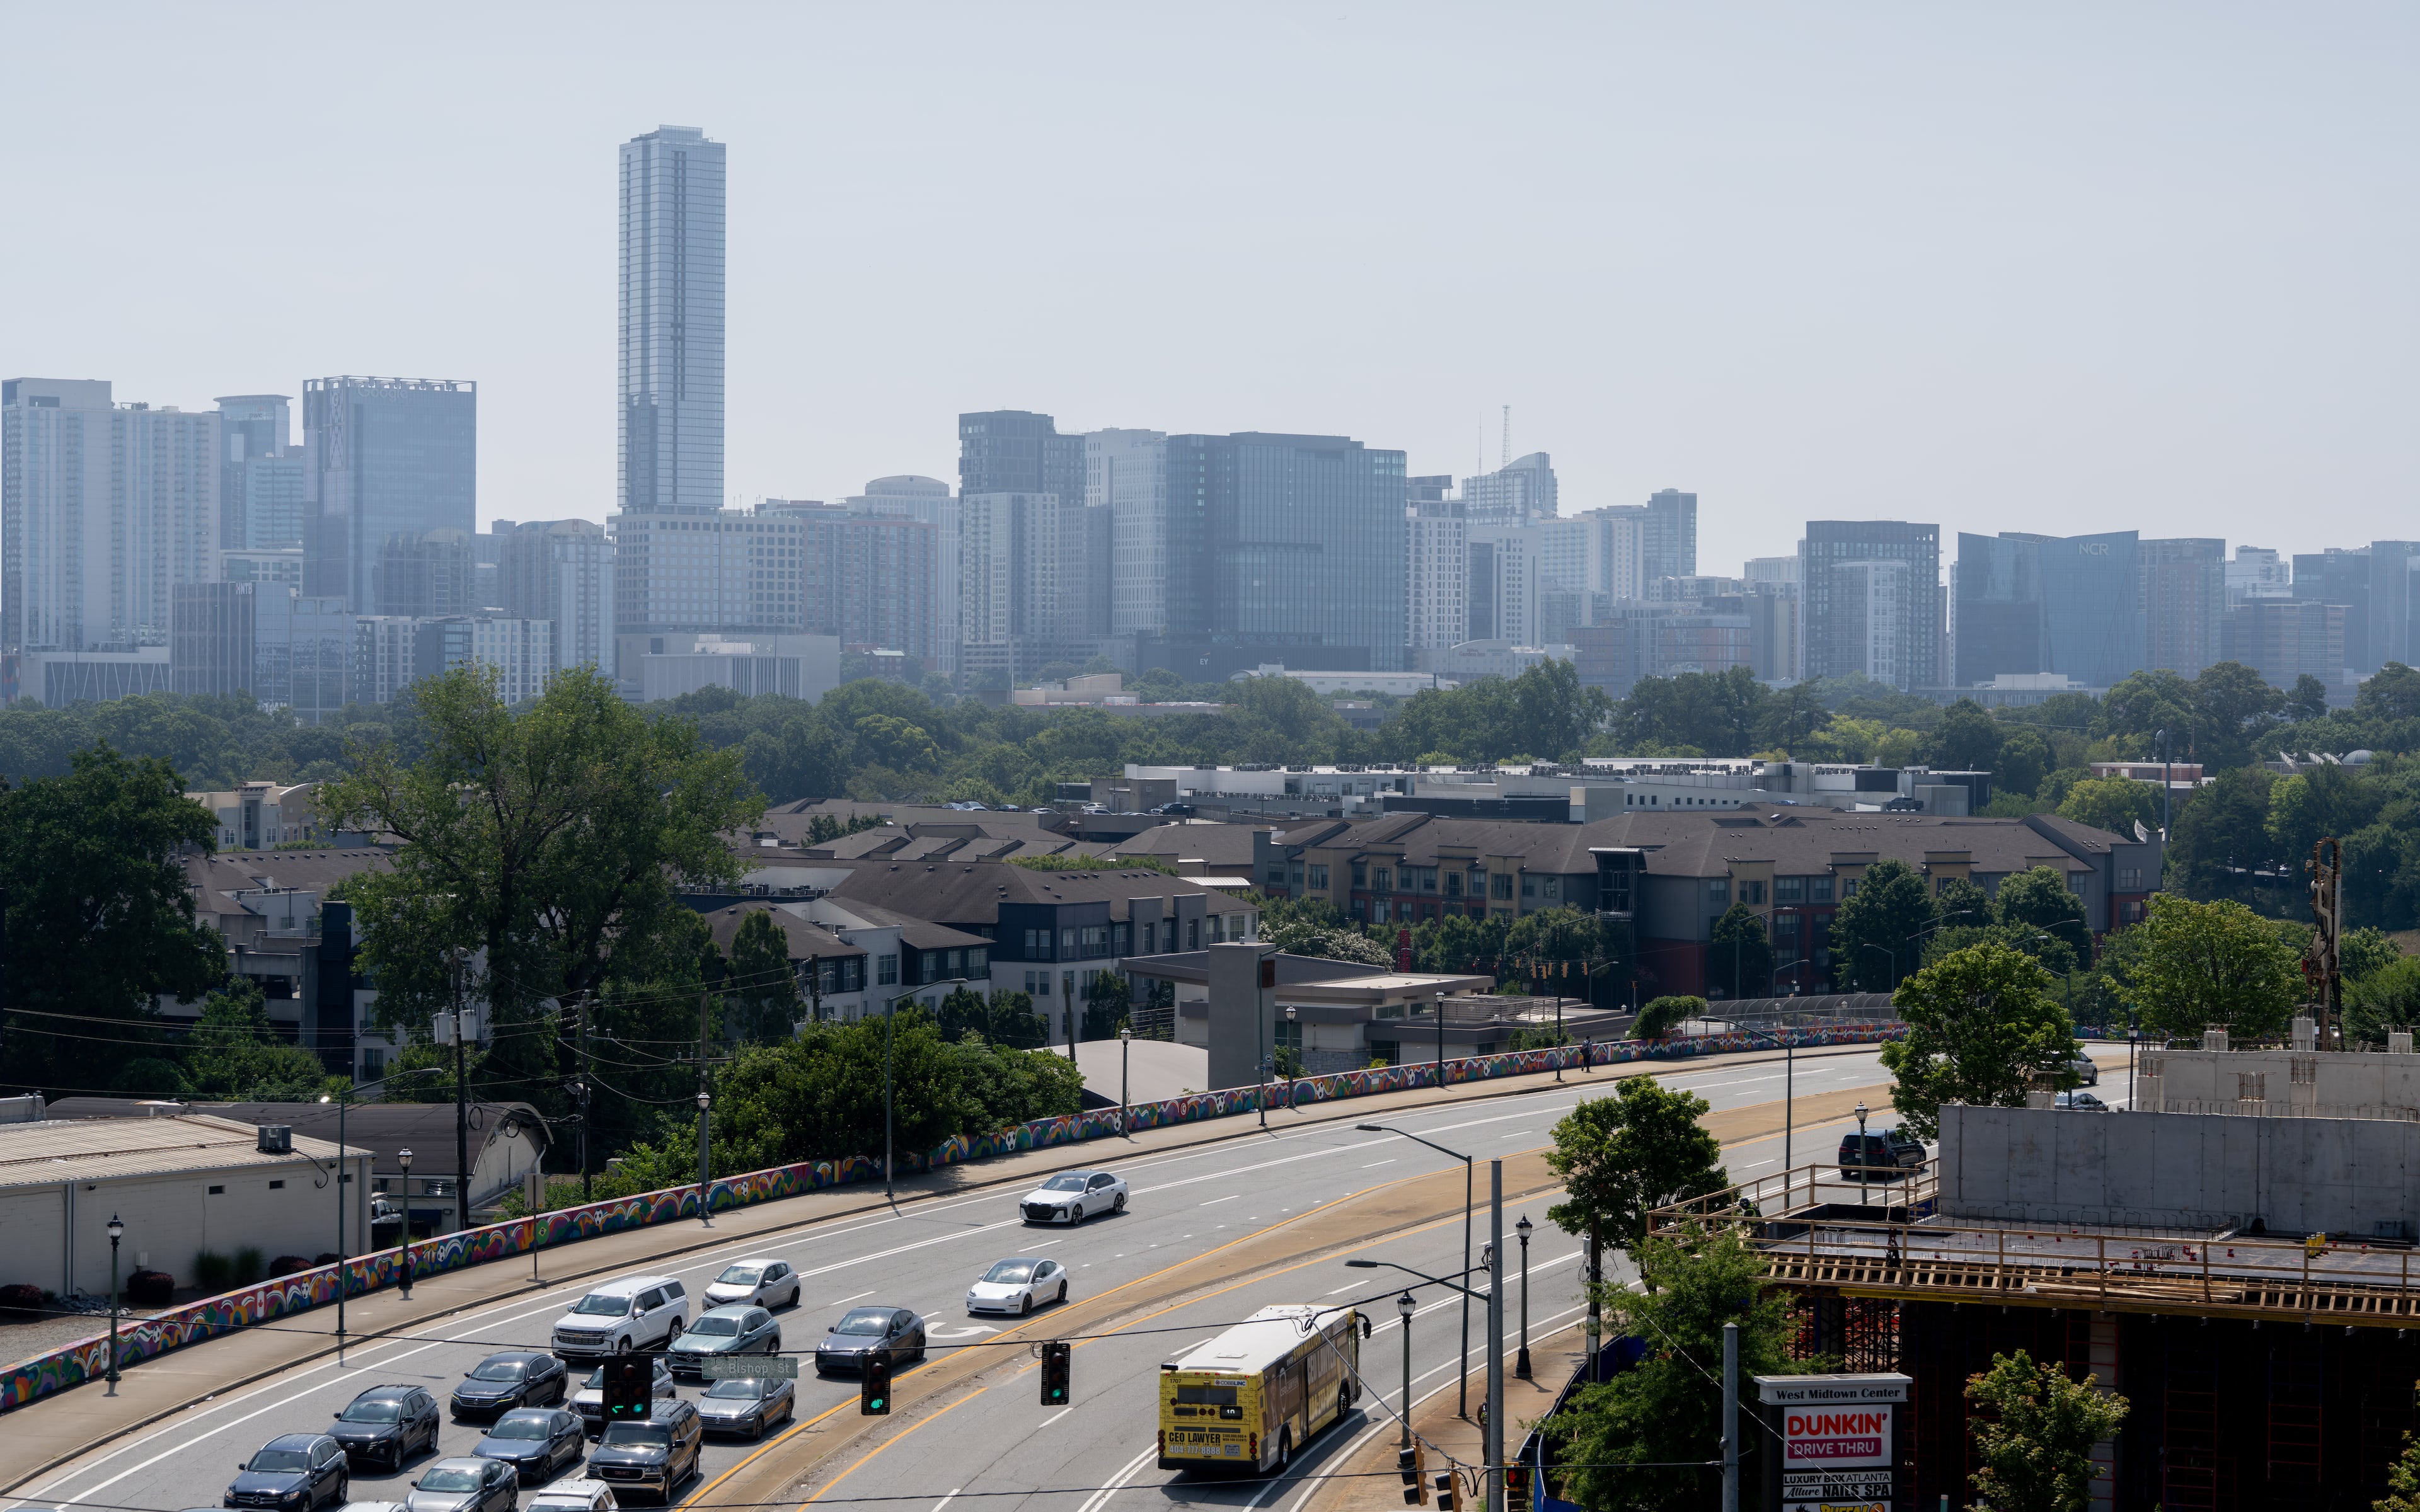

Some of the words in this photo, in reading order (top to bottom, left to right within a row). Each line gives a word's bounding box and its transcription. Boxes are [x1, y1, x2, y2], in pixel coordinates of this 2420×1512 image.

[357, 383, 408, 403] Google
[2079, 543, 2109, 555] NCR
[236, 582, 253, 595] HNTB
[729, 1363, 768, 1375] Bishop
[778, 1363, 790, 1373] St
[1777, 1390, 1804, 1400] West
[1809, 1389, 1857, 1399] Midtown
[1861, 1388, 1900, 1398] Center
[1788, 1412, 1887, 1436] DUNKIN'
[1169, 1432, 1185, 1442] CEO
[1188, 1432, 1221, 1443] LAWYER
[1169, 1445, 1221, 1455] 404-777-8888
[1794, 1442, 1834, 1455] DRIVE
[1838, 1441, 1874, 1454] THRU
[1784, 1475, 1822, 1484] LUXURY
[1824, 1474, 1845, 1483] BOX
[1846, 1473, 1890, 1482] ATLANTA
[1785, 1487, 1821, 1498] Allure
[1823, 1484, 1859, 1497] NAILS
[1864, 1484, 1890, 1496] SPA
